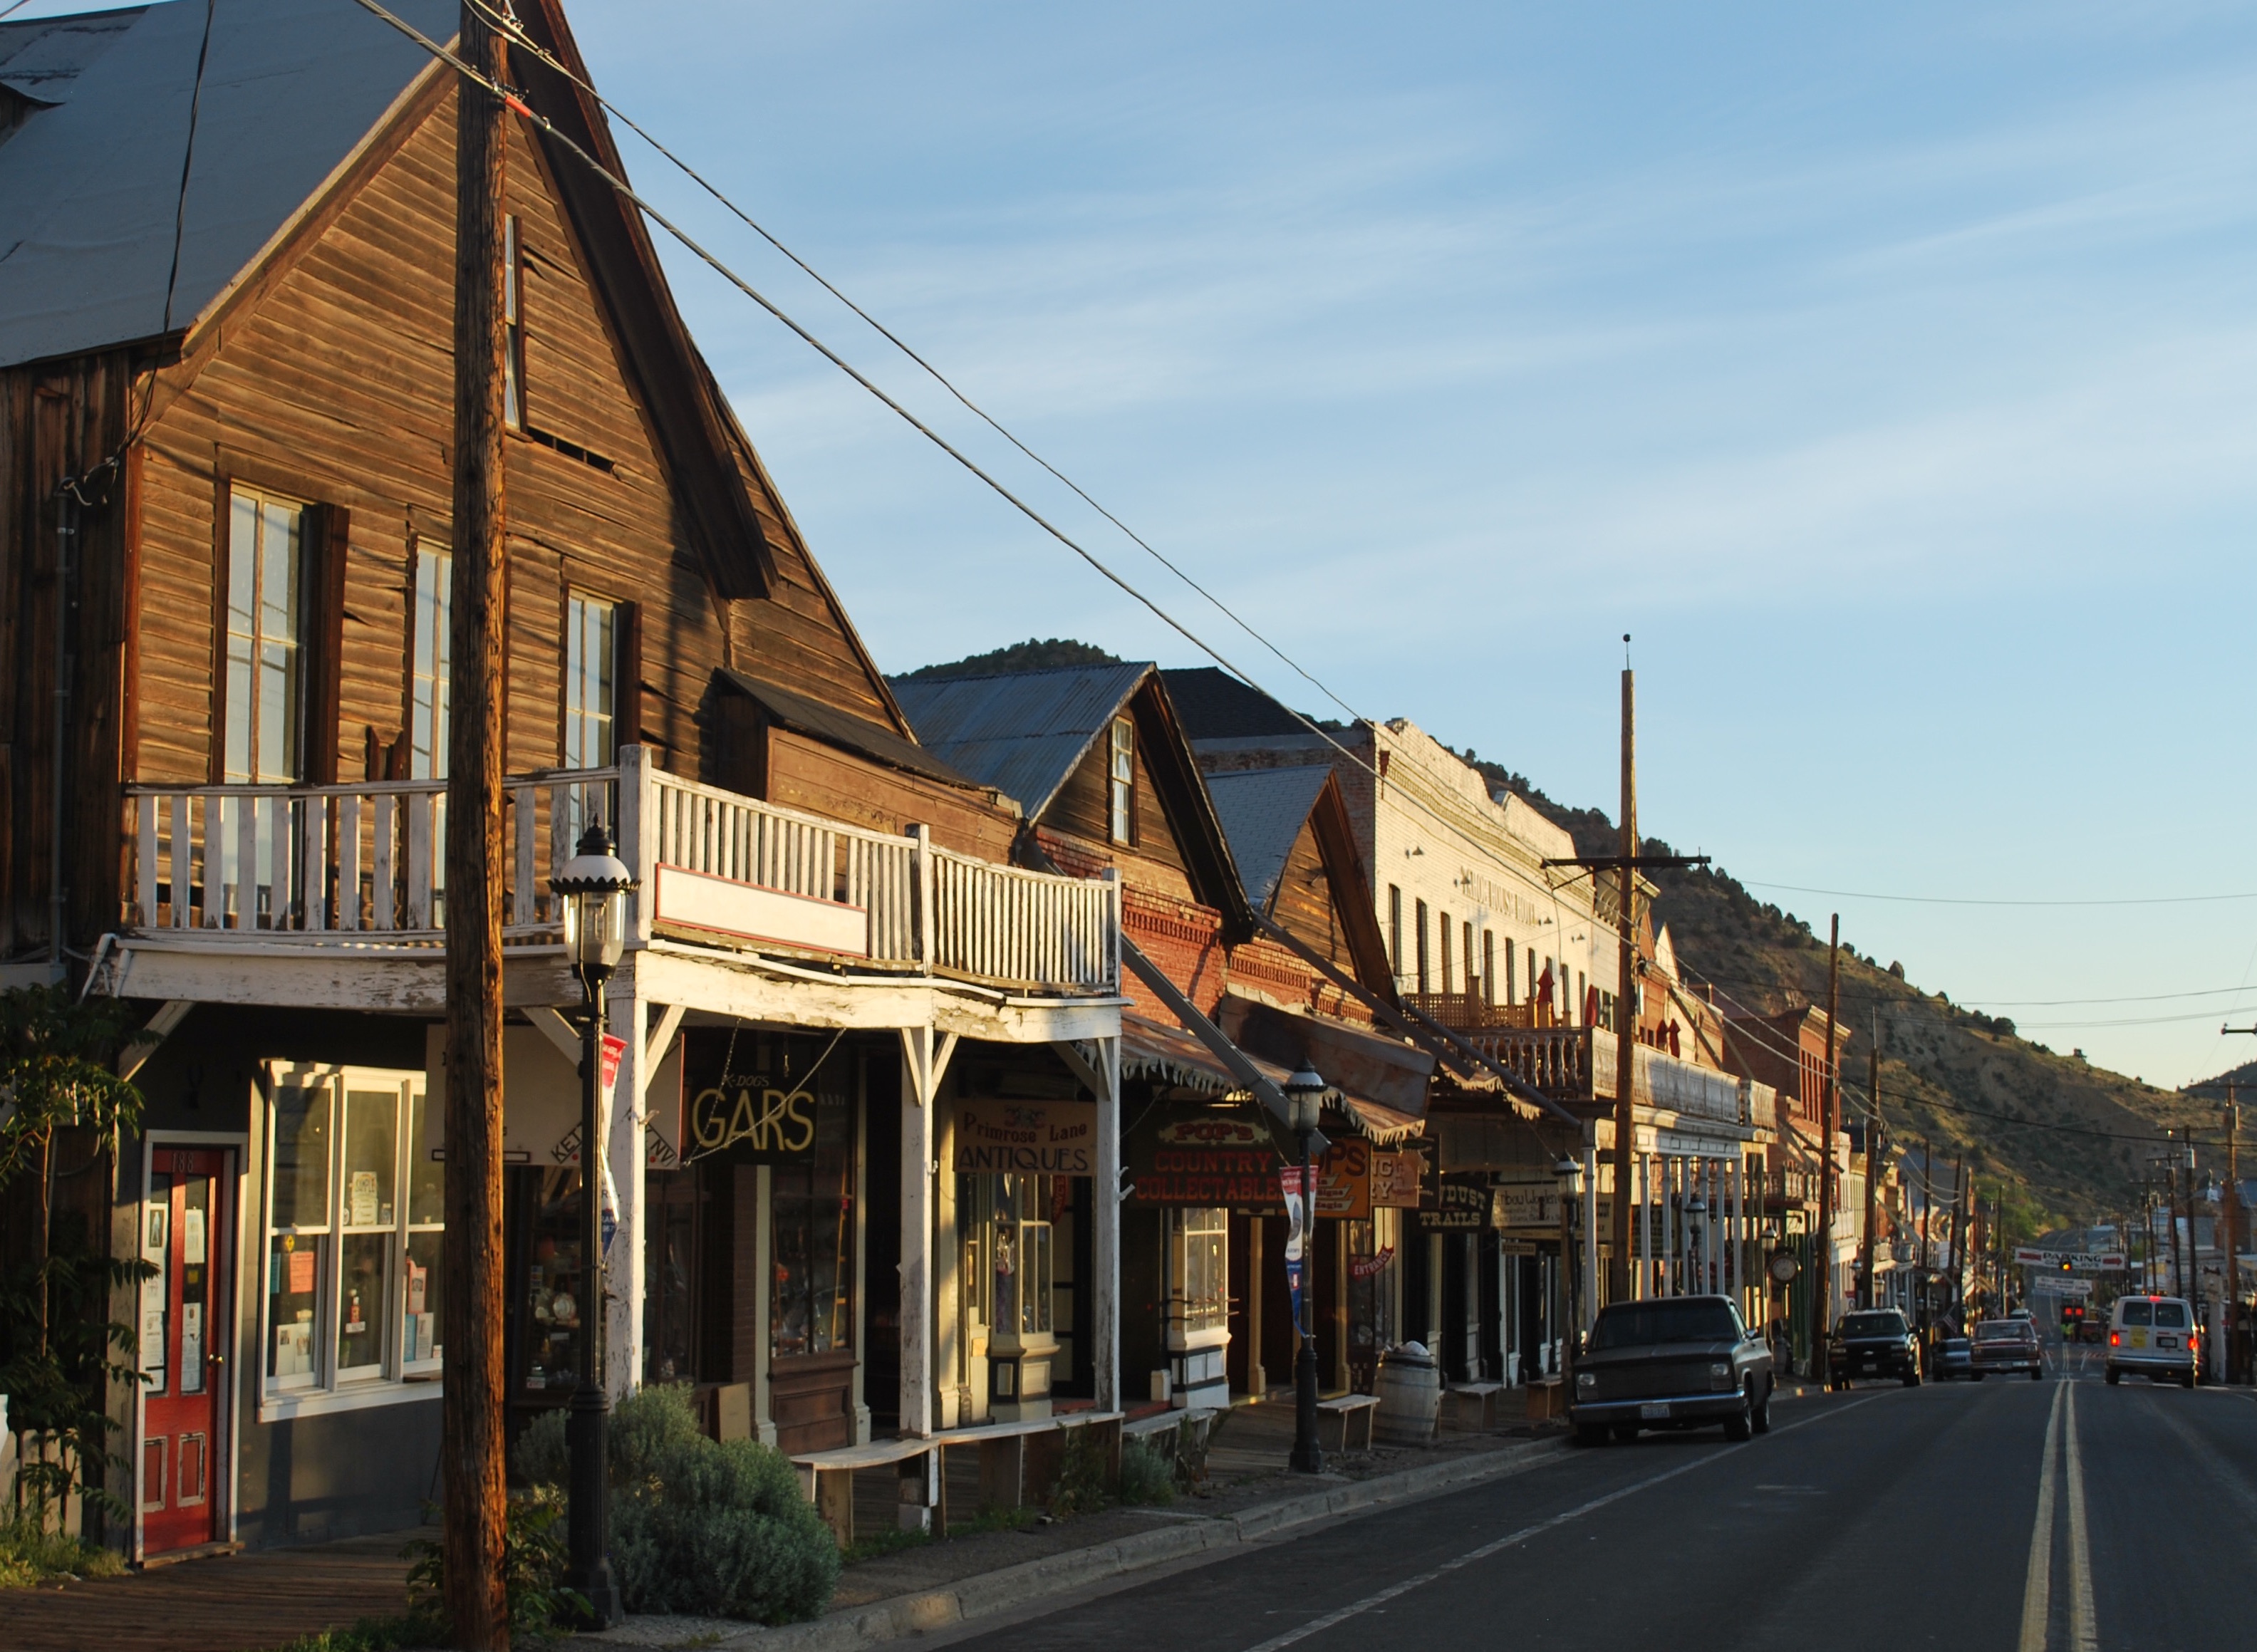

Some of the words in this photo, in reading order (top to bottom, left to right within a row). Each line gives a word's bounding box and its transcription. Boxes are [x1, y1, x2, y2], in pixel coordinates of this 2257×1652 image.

[1488, 880, 1513, 916] HOUSE
[1515, 894, 1537, 925] HOTEL
[692, 1088, 815, 1151] GARS
[964, 1112, 1037, 1143] Primrose
[1049, 1123, 1087, 1141] Lane
[1174, 1123, 1254, 1141] POP'S
[551, 1122, 583, 1163] KET
[650, 1138, 674, 1163] NV
[172, 1151, 194, 1173] 188
[958, 1146, 1089, 1171] ANTIQUES
[1154, 1151, 1273, 1173] COUNTRY
[1419, 1212, 1480, 1226] TRAILS
[1354, 1249, 1391, 1275] ENTRANCE
[2043, 1252, 2101, 1262] PARKING
